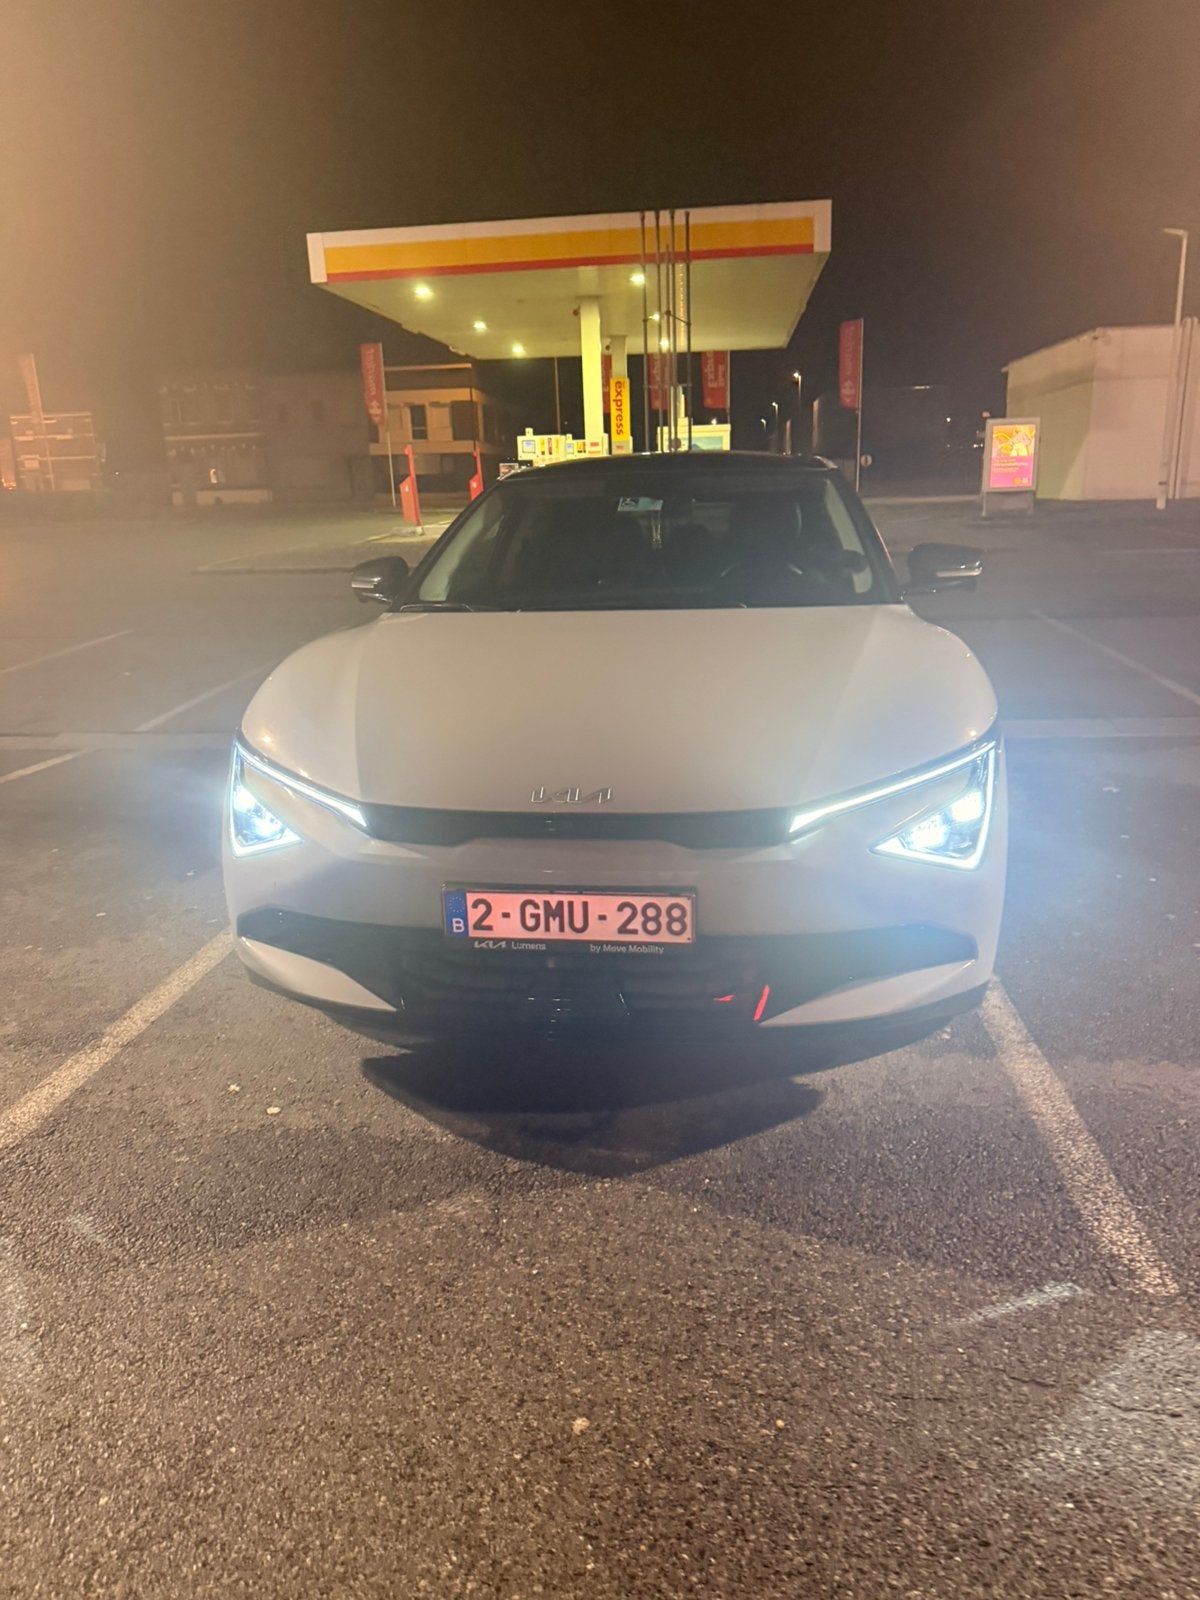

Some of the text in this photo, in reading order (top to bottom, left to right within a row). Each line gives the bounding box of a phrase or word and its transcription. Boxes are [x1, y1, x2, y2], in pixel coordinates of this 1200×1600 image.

[614, 380, 624, 436] express
[452, 918, 465, 933] B
[511, 941, 546, 950] Lumens
[590, 943, 665, 954] by Move Mobility
